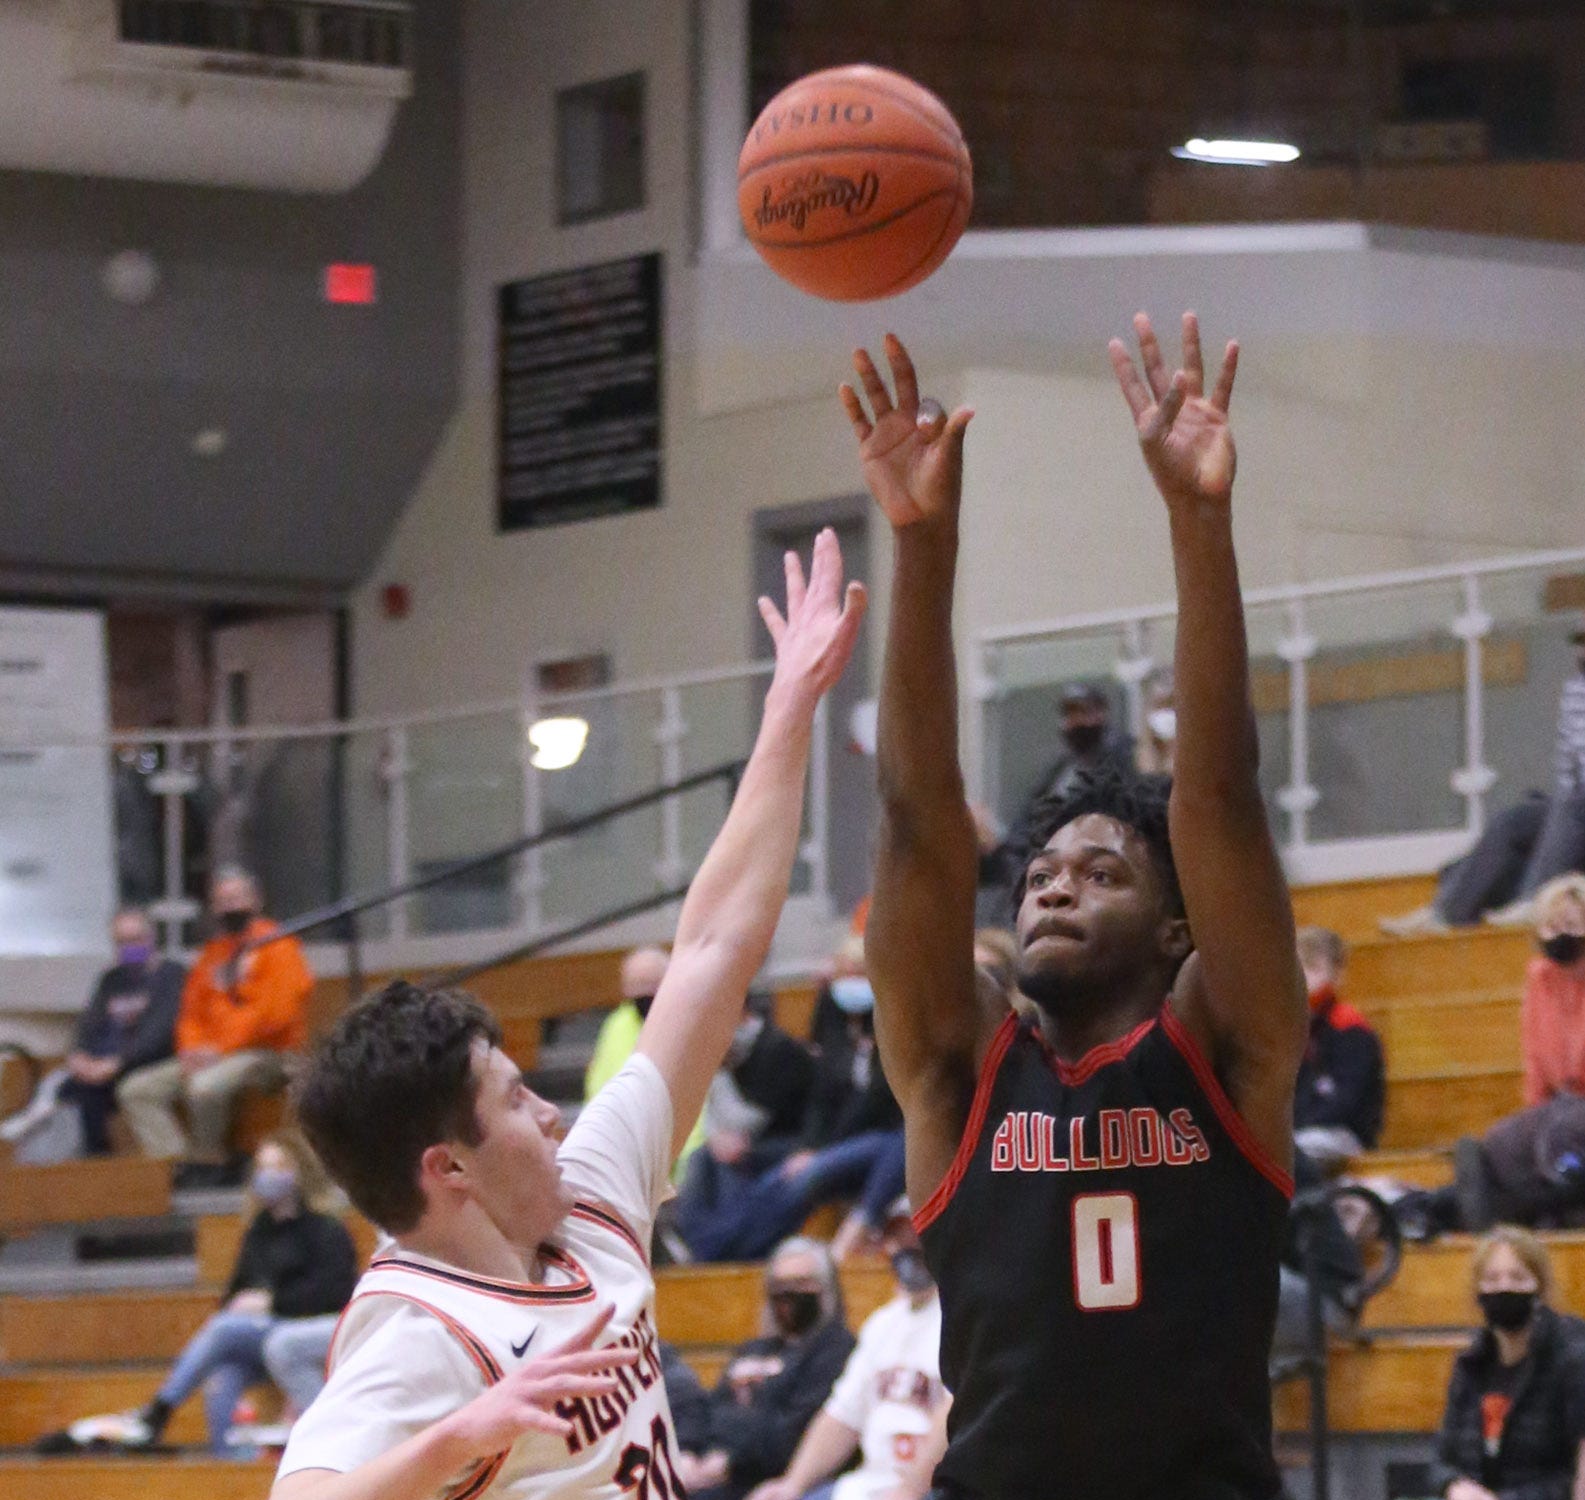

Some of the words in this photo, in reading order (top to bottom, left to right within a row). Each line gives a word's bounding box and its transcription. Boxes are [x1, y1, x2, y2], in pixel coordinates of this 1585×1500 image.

[754, 169, 880, 232] Rawlings
[991, 1107, 1211, 1172] BULLDOGS
[1070, 1190, 1143, 1312] 0
